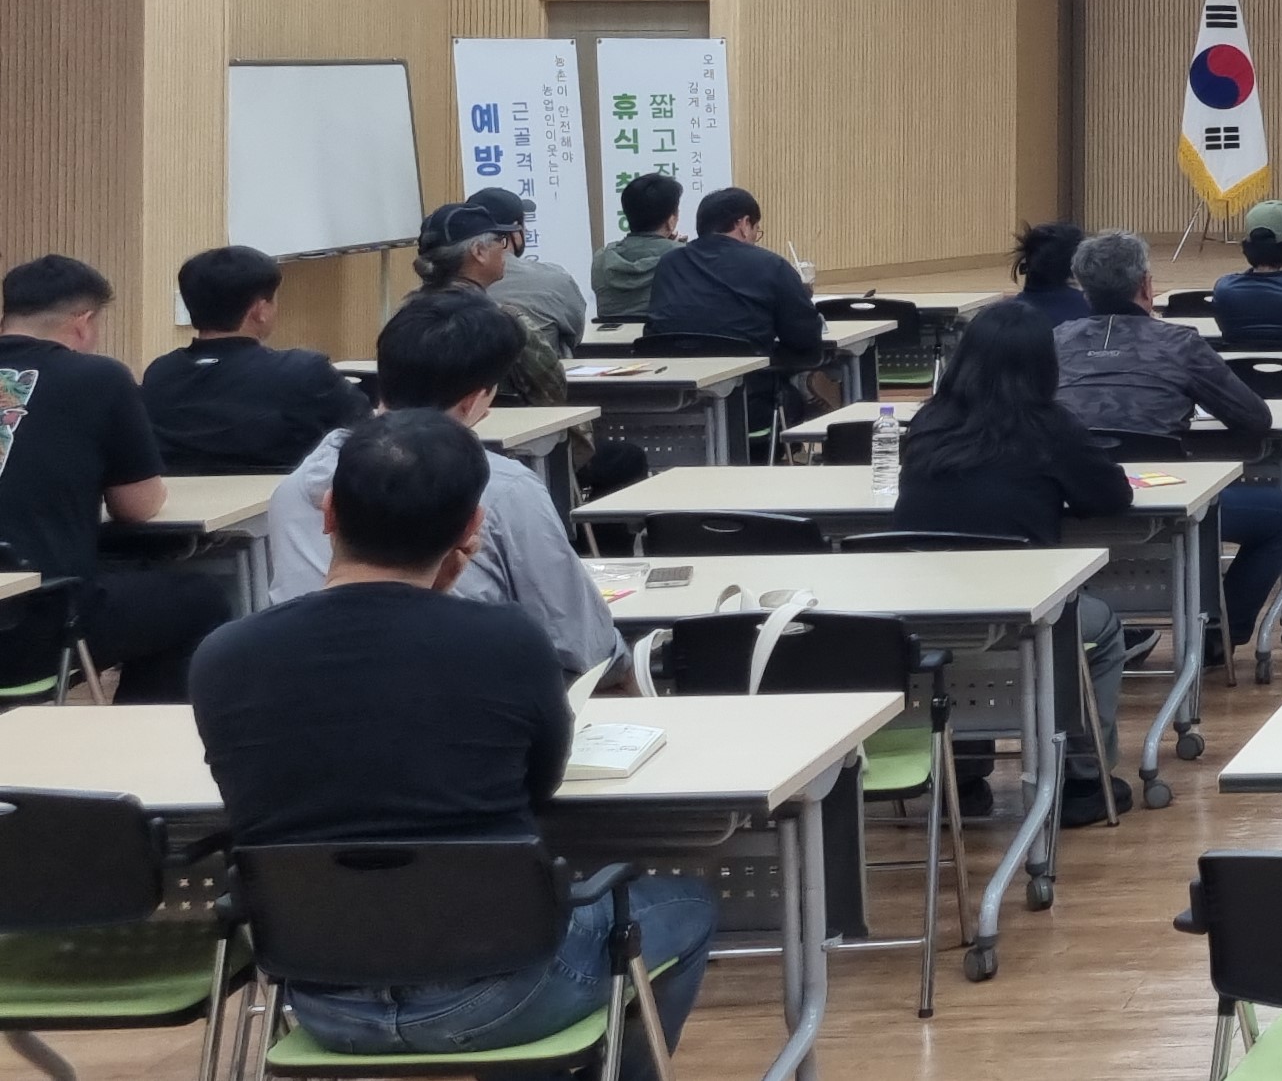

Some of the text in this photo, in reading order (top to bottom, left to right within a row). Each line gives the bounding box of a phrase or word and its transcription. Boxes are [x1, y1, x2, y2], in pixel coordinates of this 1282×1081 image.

[703, 54, 717, 129] 오래 일하고
[471, 102, 503, 177] 예방
[558, 105, 574, 163] 안전해야
[612, 93, 639, 154] 휴식
[649, 94, 677, 152] 짧고
[691, 151, 703, 193] 것보다
